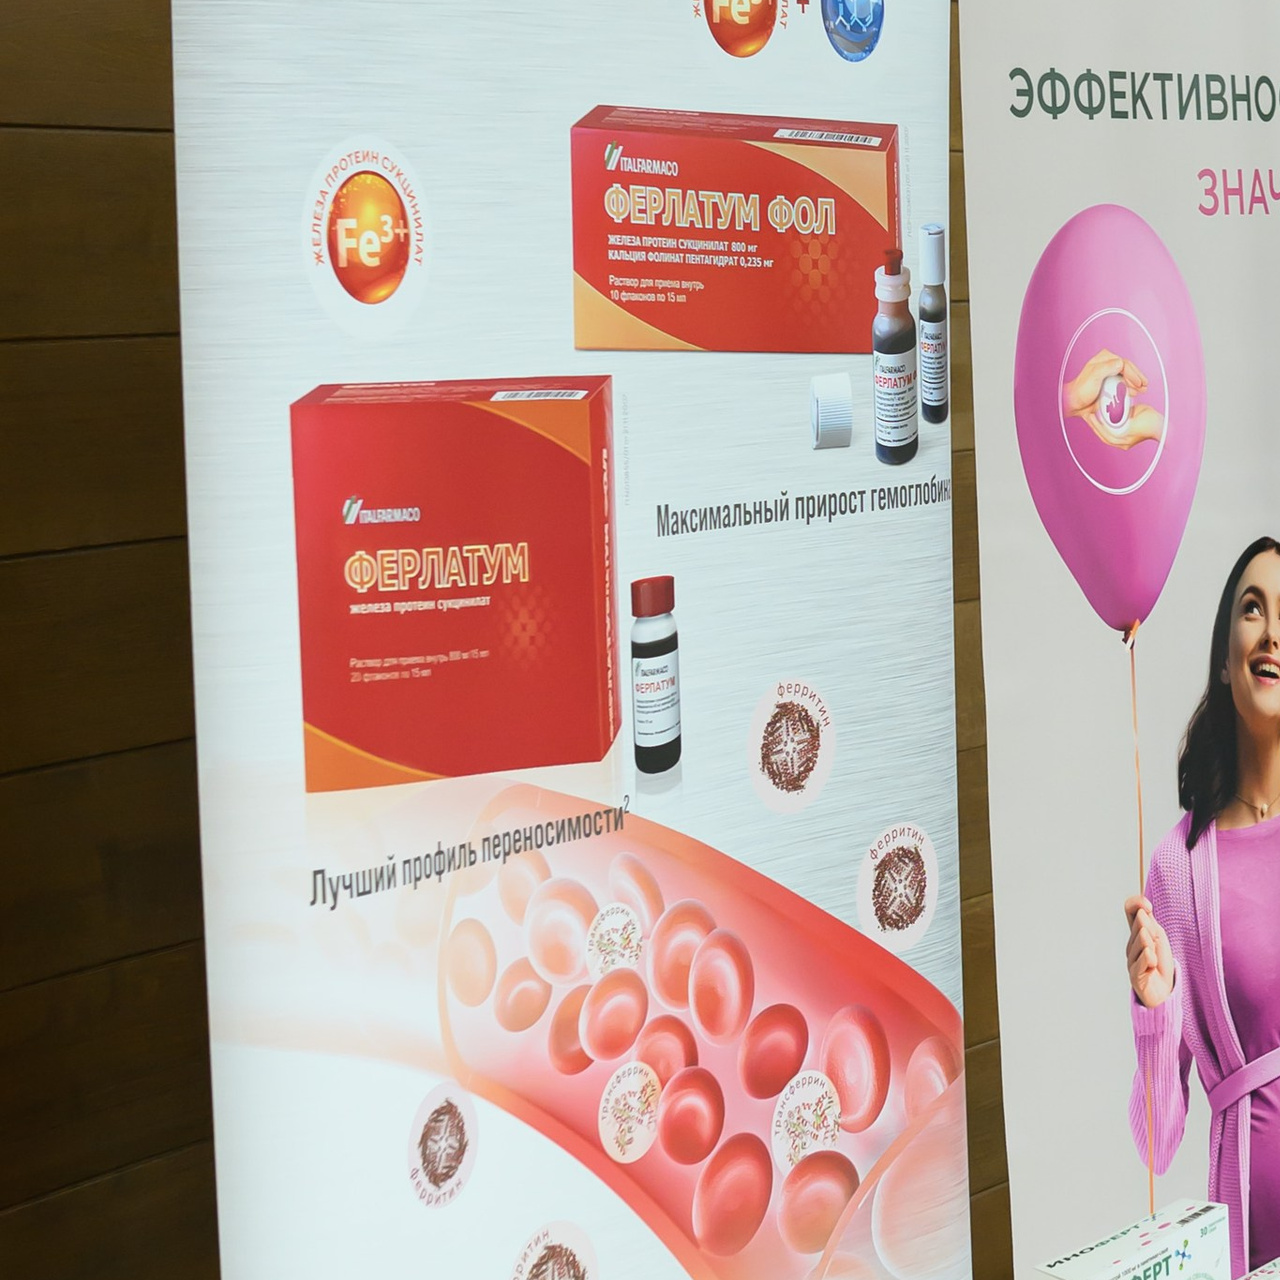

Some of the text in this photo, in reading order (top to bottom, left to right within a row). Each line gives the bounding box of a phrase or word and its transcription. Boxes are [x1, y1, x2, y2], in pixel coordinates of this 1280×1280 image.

[620, 156, 679, 176] ITALFARMACO
[312, 150, 424, 266] ЖЕЛЕЗА ПРОТЕИН СУКЦИНИЛАТ
[604, 183, 836, 235] ФЕРЛАТУМ ФОЛ
[608, 234, 758, 252] ЖЕЛЕЗА ПРОТЕИН СУКЦИНИЛАТ 800 мг
[608, 250, 773, 268] КАЛЬЦИЯ ФОЛИНАТ ПЕНТАГИДРАТ 0,235 мг
[609, 275, 638, 288] Раствор
[656, 490, 790, 538] Максимальный
[795, 489, 867, 526] прирост
[344, 542, 530, 593] ФЕРЛАТУМ
[350, 596, 491, 614] железа протеин сукцинилат
[777, 682, 830, 727] ферритин
[869, 826, 925, 860] ферритин
[310, 853, 397, 911] Лучший
[402, 840, 476, 890] профиль
[601, 1064, 650, 1121] трансферрин
[774, 1074, 826, 1136] трансферрин
[409, 1167, 463, 1206] ферритин
[1046, 1224, 1141, 1269] ИНОФЕРТ
